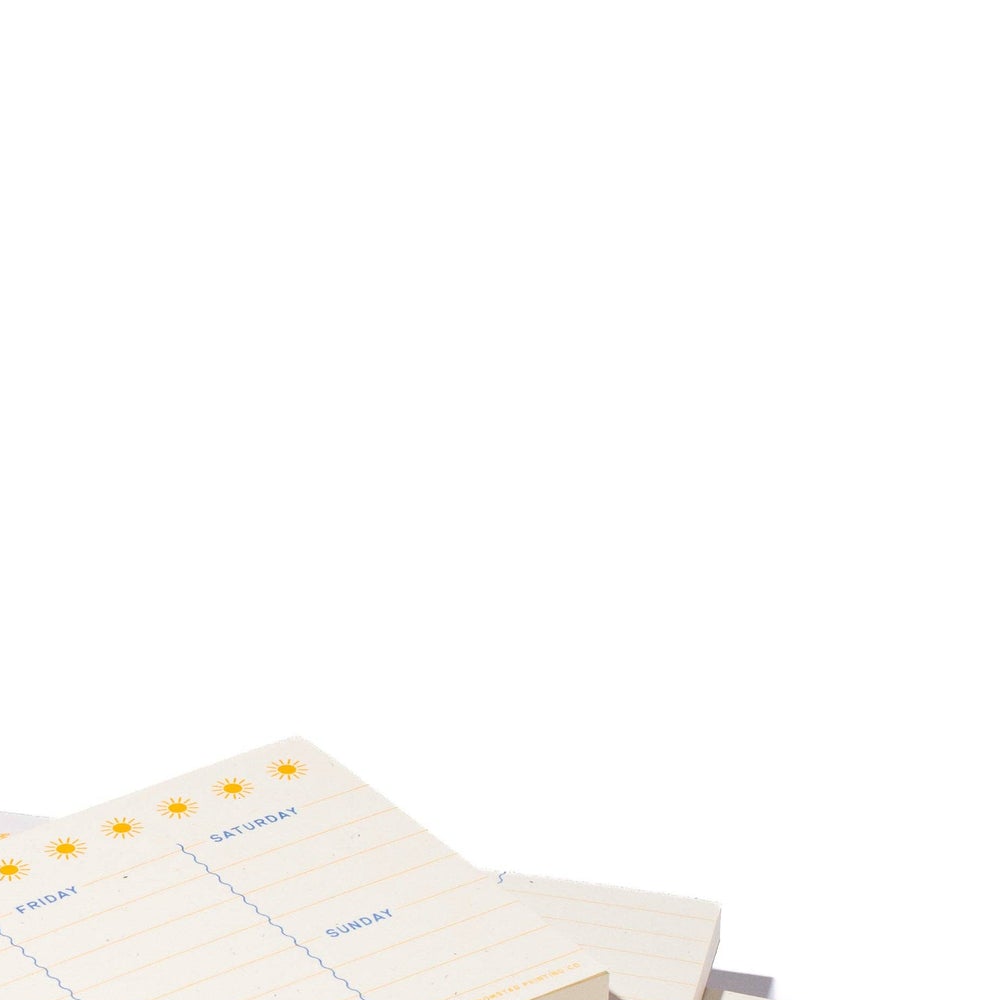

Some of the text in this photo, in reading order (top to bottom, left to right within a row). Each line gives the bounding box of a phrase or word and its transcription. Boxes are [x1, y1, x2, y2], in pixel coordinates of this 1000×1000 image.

[210, 807, 298, 843] SATURDAY
[15, 886, 77, 914] FRIDAY
[325, 908, 392, 938] SUNDAY
